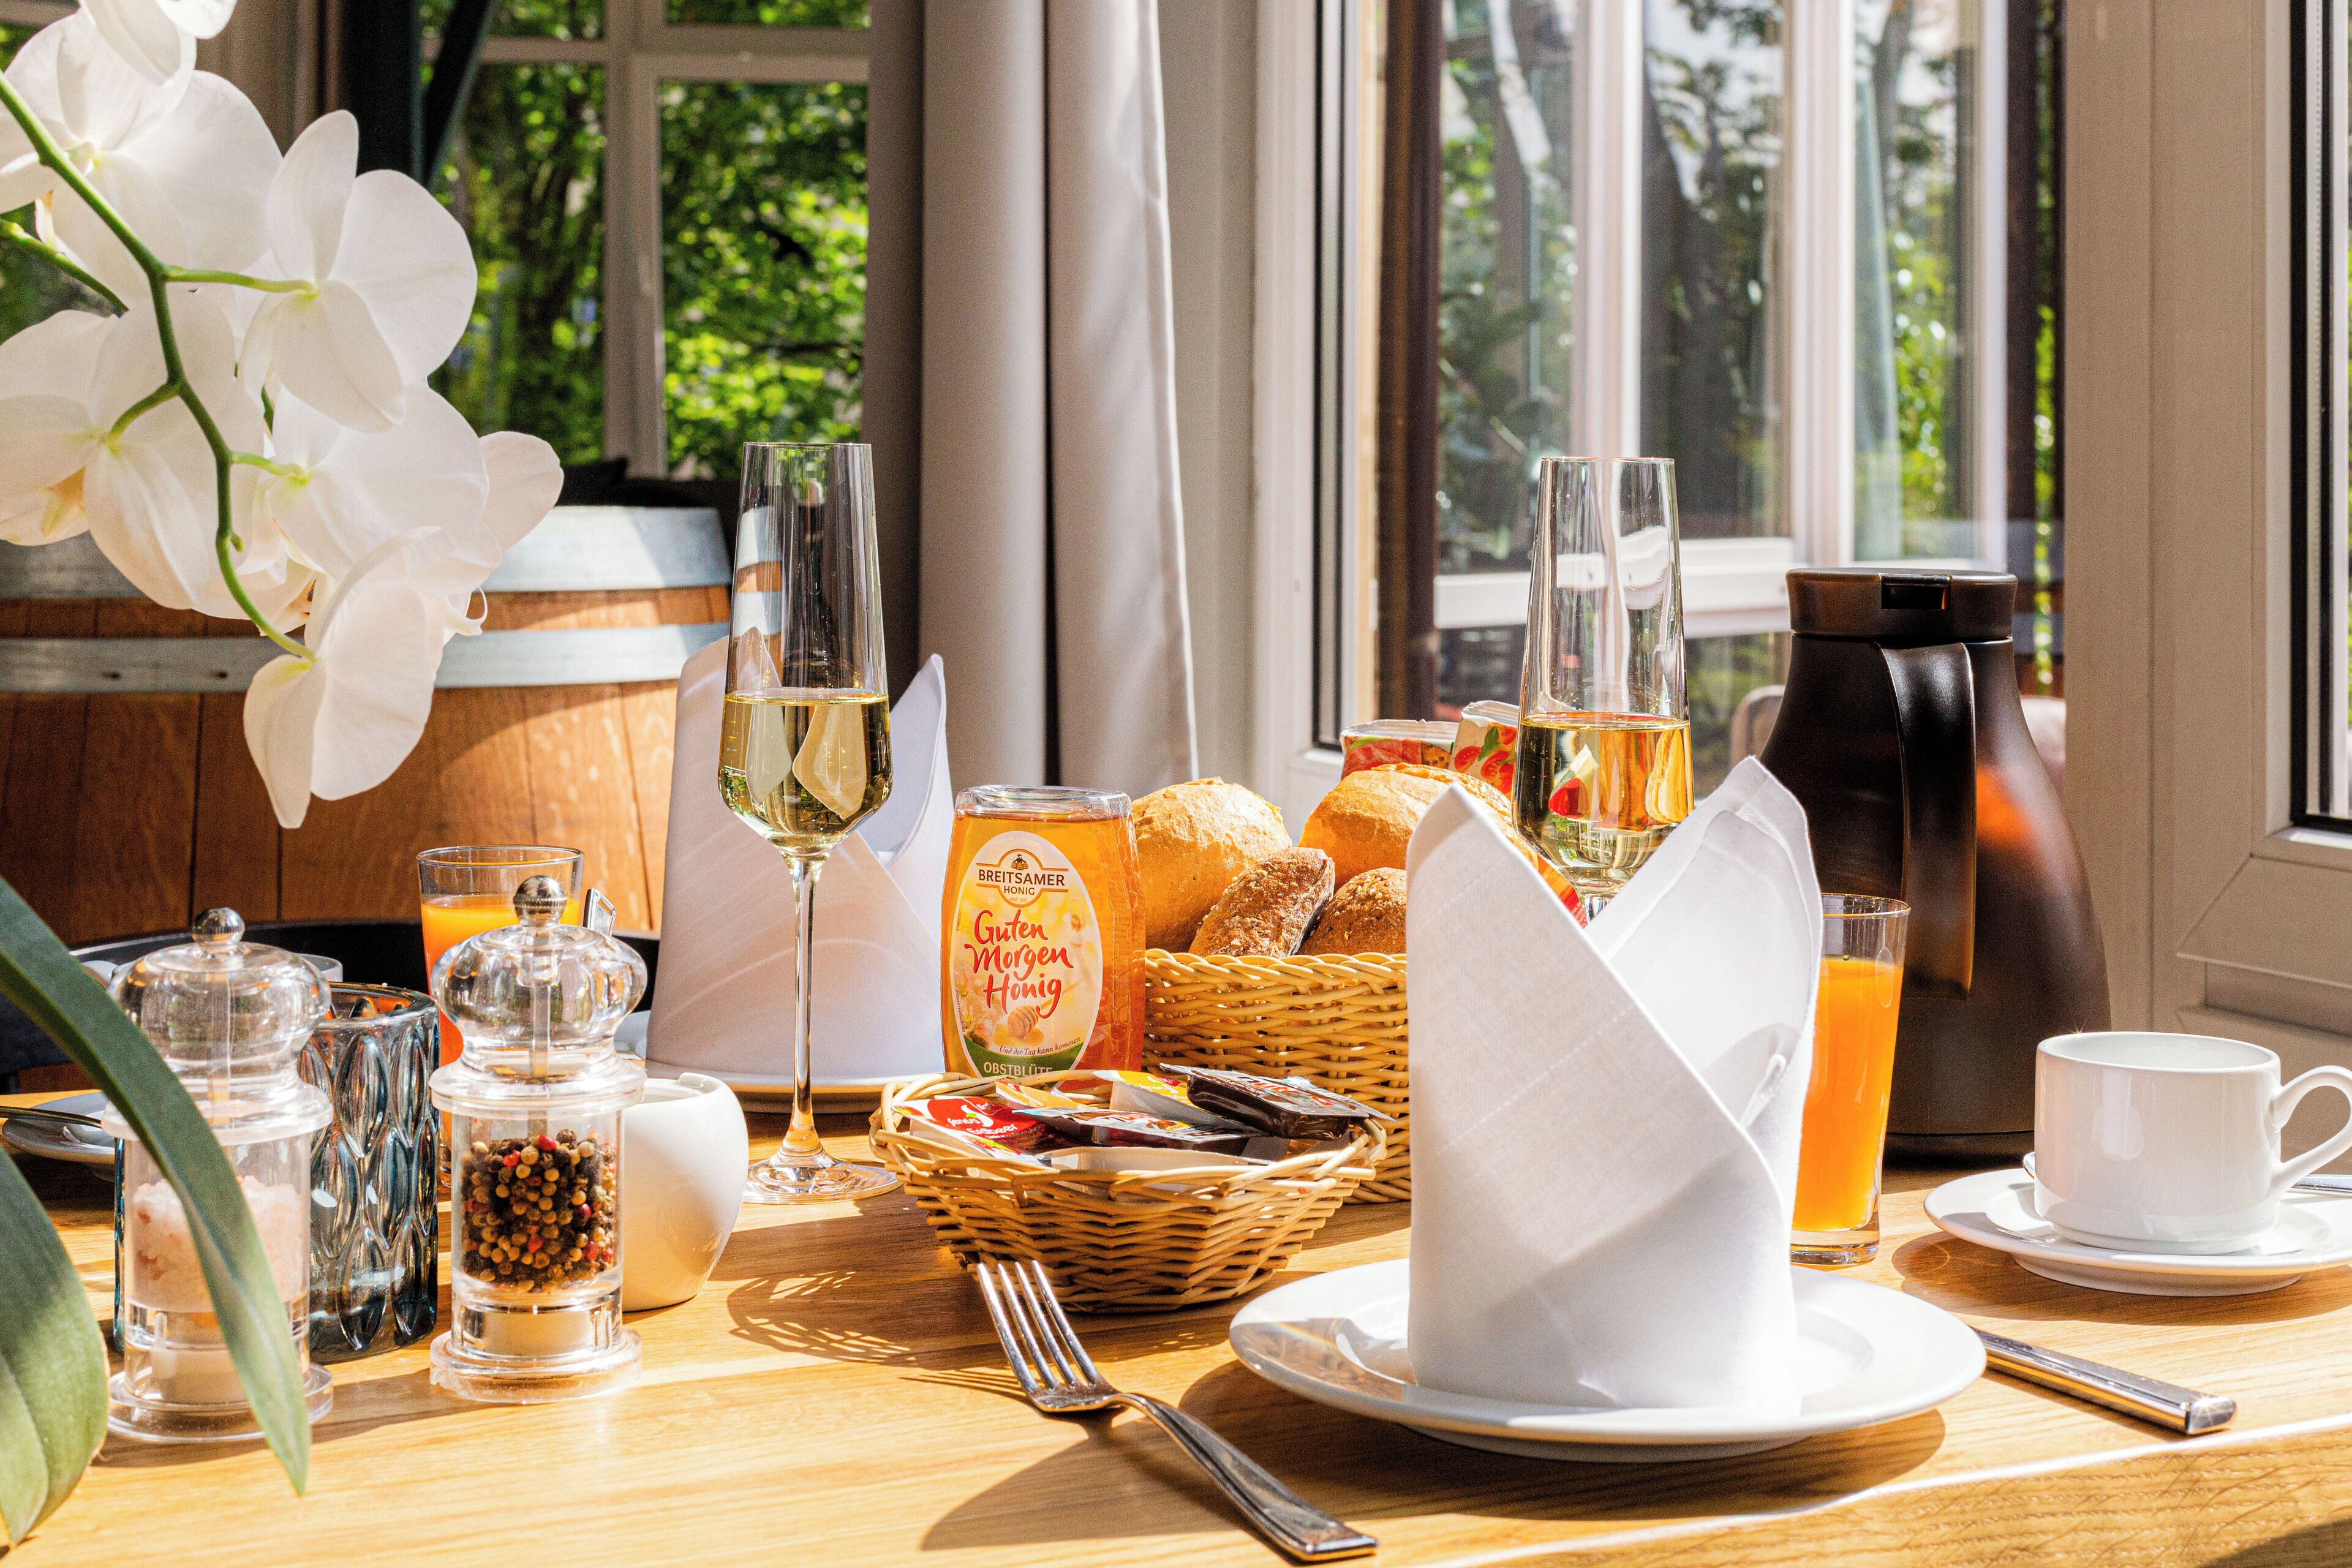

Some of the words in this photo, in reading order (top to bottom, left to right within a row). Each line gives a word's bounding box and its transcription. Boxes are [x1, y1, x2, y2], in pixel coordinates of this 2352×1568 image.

[979, 869, 1065, 886] BREITSAMER
[1004, 886, 1035, 895] HONIG
[974, 908, 1049, 946] Guten
[963, 943, 1074, 981] Morgen
[982, 973, 1062, 1019] Honig
[1000, 1046, 1012, 1054] Und
[1023, 1047, 1036, 1057] Tag
[1055, 1036, 1080, 1051] kommen
